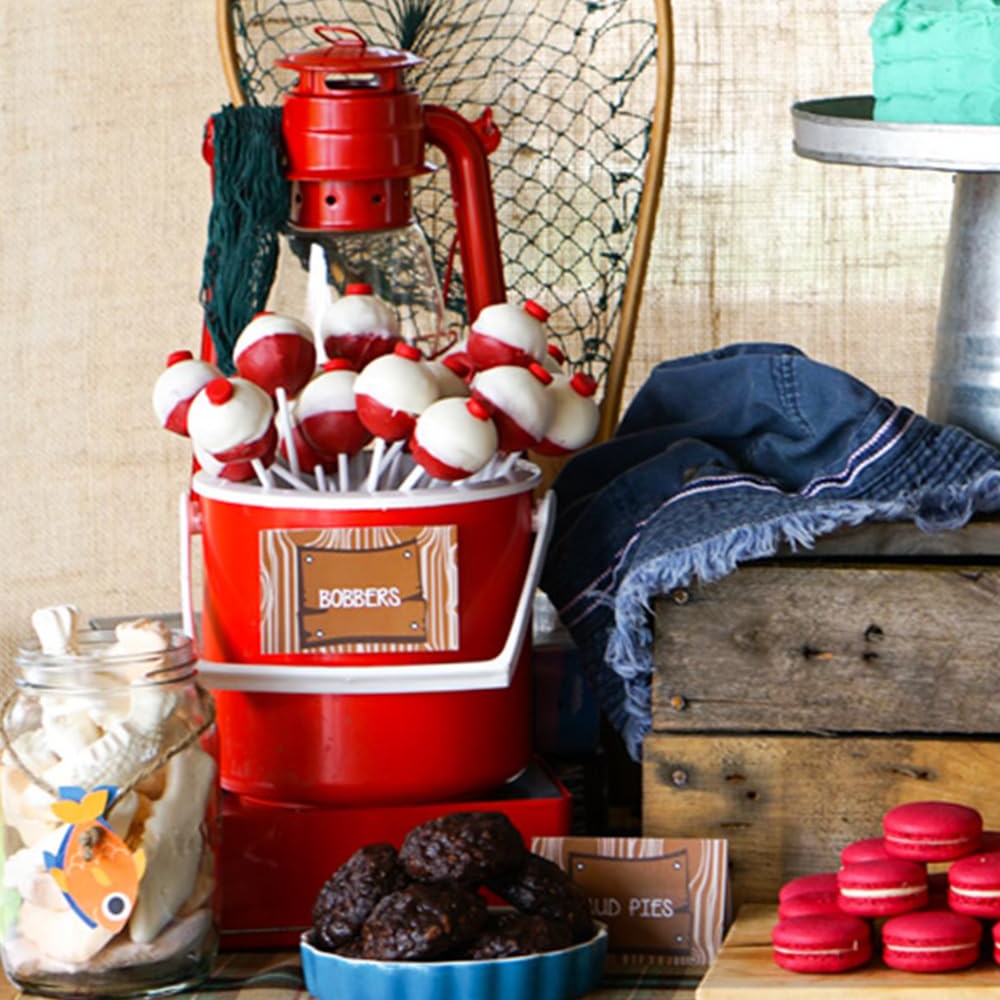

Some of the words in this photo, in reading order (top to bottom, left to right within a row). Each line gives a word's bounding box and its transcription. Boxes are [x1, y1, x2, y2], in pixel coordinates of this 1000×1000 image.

[318, 587, 402, 608] BOBBERS
[588, 898, 621, 917] UD
[628, 898, 674, 918] PIES
